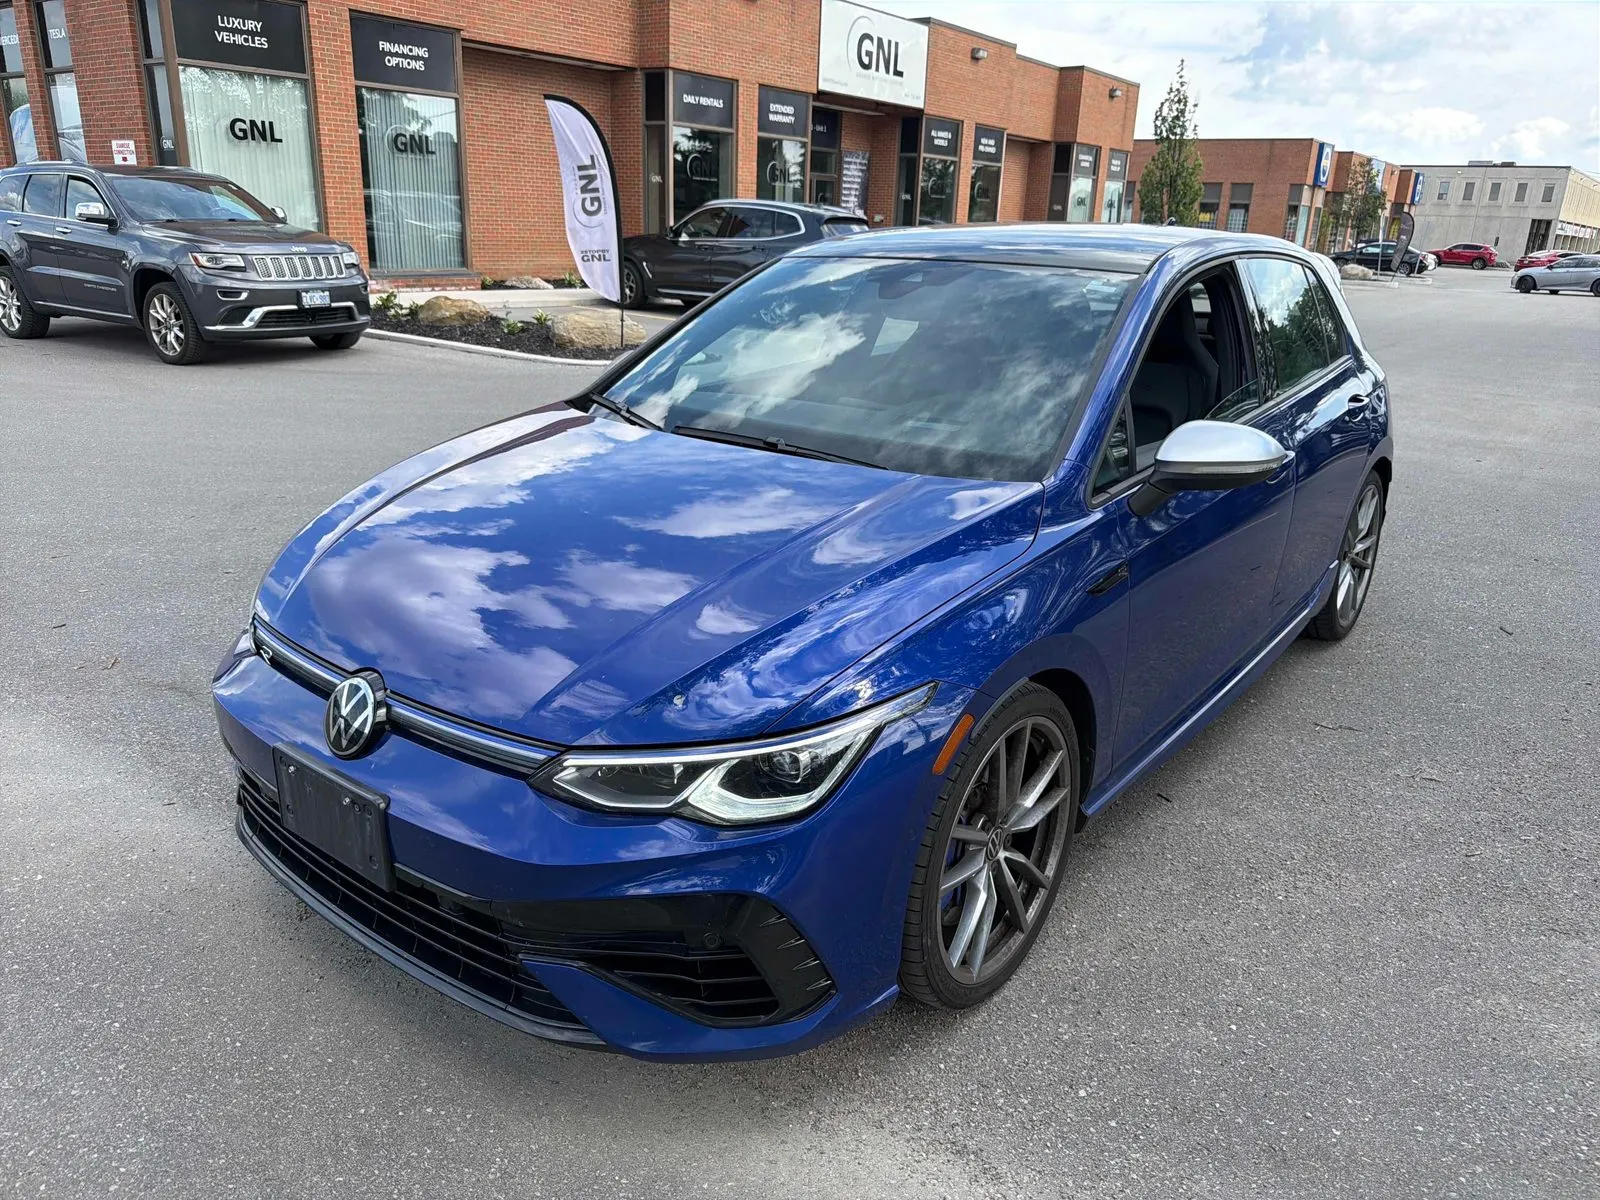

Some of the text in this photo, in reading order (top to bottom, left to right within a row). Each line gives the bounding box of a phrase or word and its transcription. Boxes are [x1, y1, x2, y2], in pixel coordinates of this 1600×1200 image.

[217, 15, 262, 32] LUXURY
[48, 28, 66, 39] TESLA
[214, 30, 268, 49] VEHICLES
[379, 41, 429, 58] FINANCING
[856, 32, 905, 78] GNL
[385, 56, 425, 71] OPTIONS
[683, 94, 724, 108] DAILY RENTALS
[769, 103, 795, 114] EXTENDED
[768, 113, 795, 124] WARRANTY
[229, 117, 283, 143] GNL
[162, 140, 174, 149] GNL
[393, 133, 436, 154] GNL
[577, 155, 602, 217] GNL
[581, 254, 611, 263] GNL
